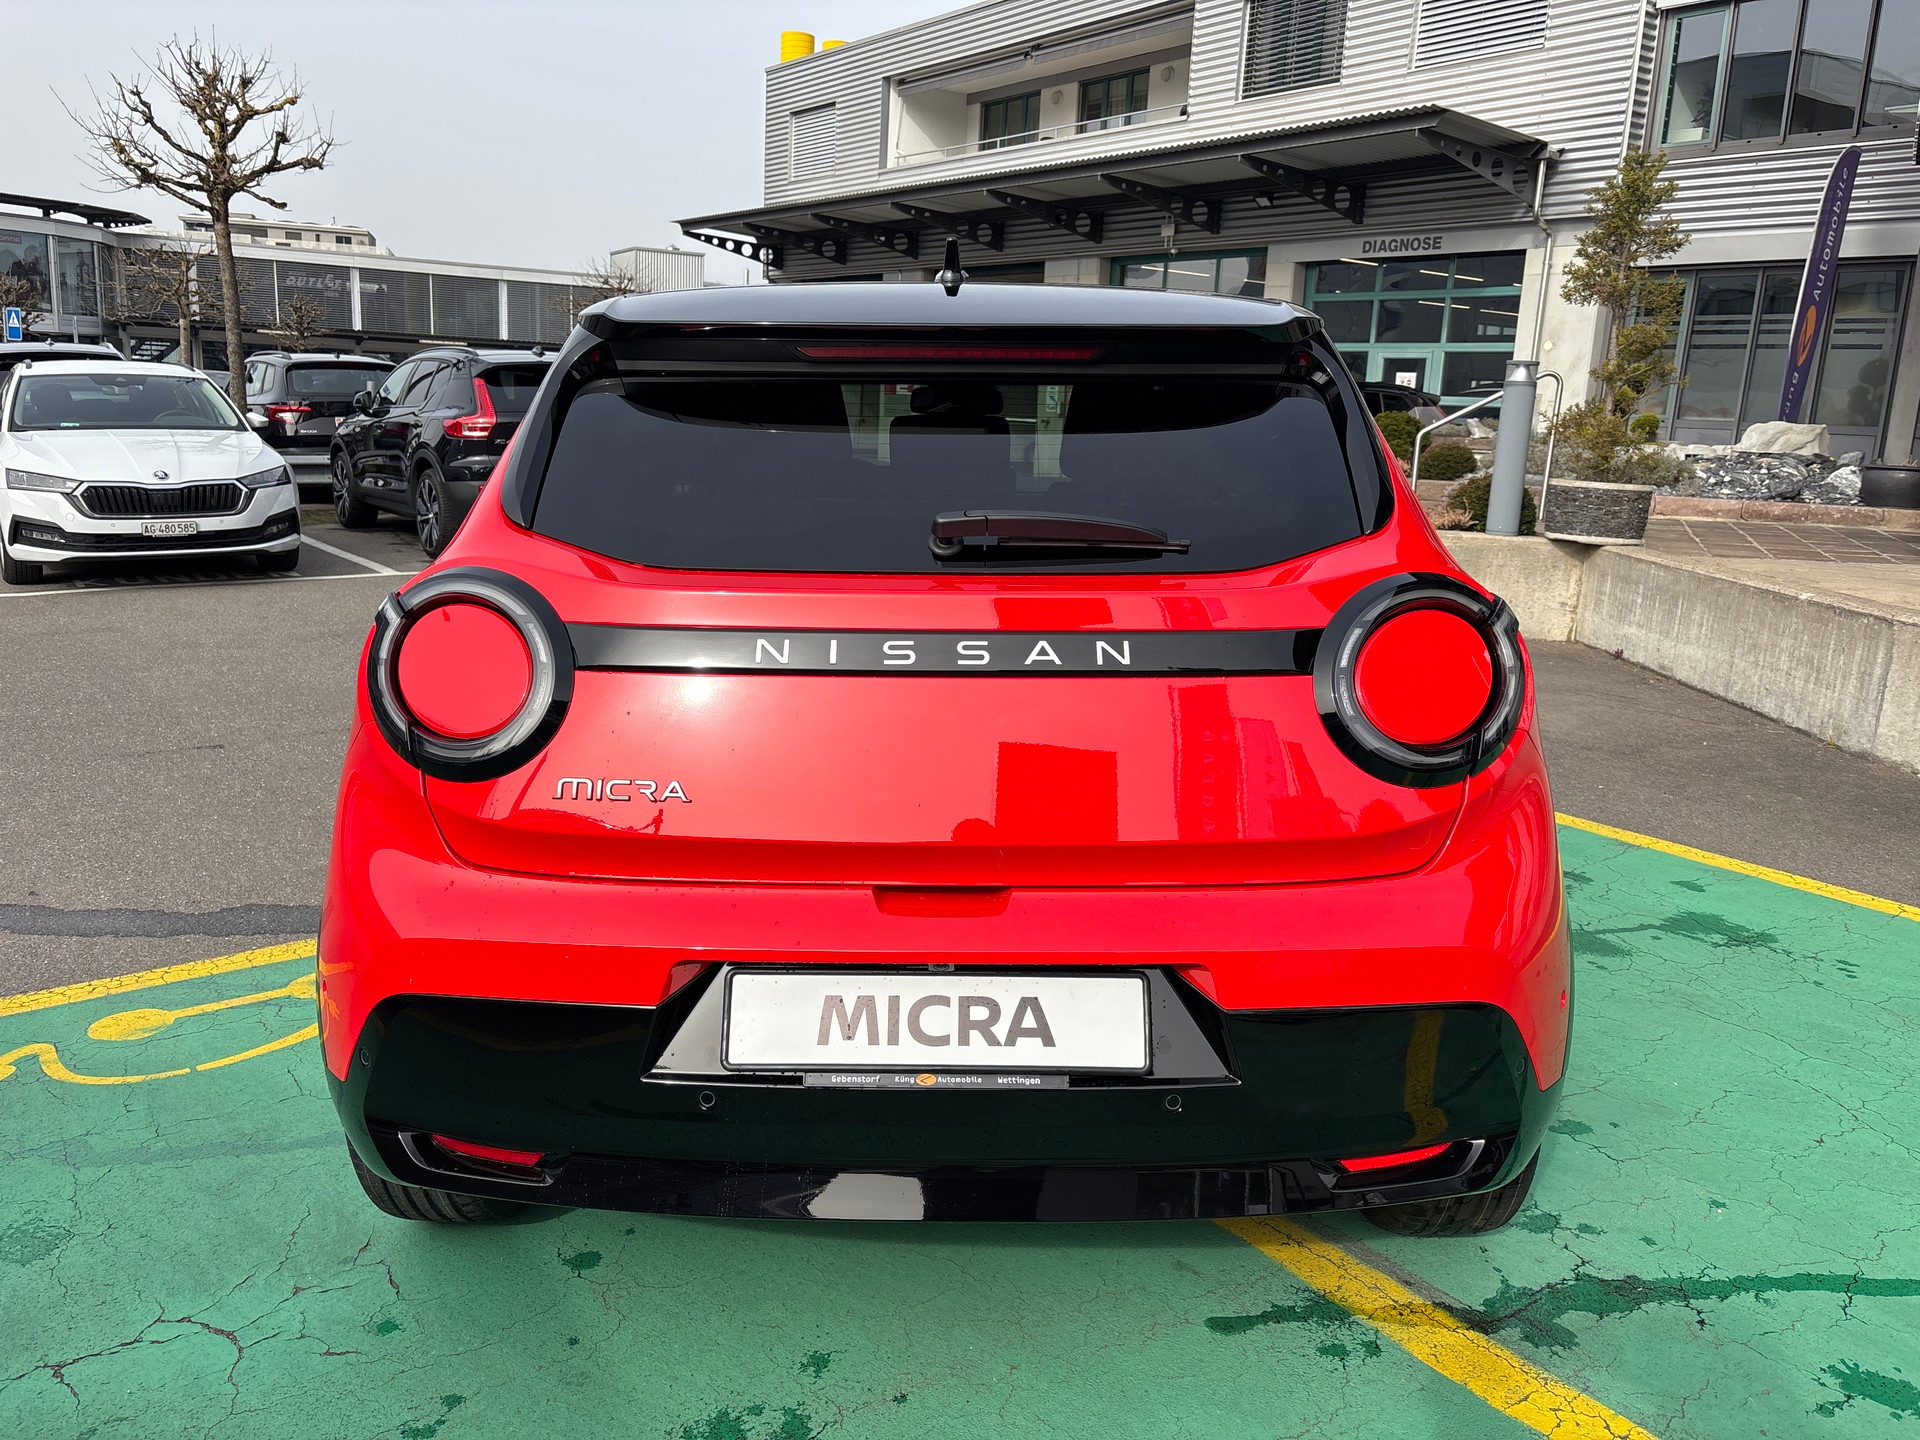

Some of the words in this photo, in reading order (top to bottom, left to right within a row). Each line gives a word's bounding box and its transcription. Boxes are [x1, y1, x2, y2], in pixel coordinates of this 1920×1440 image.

[1362, 236, 1443, 254] DIAGNOSE
[1813, 167, 1849, 301] Automobile
[755, 638, 1131, 666] NISSAN
[552, 777, 692, 803] MICRA
[817, 994, 1056, 1048] MICRA
[831, 1074, 881, 1083] Gebenstorf
[894, 1075, 915, 1084] Küng
[937, 1076, 983, 1084] Automobile
[997, 1076, 1041, 1085] Wettingen
